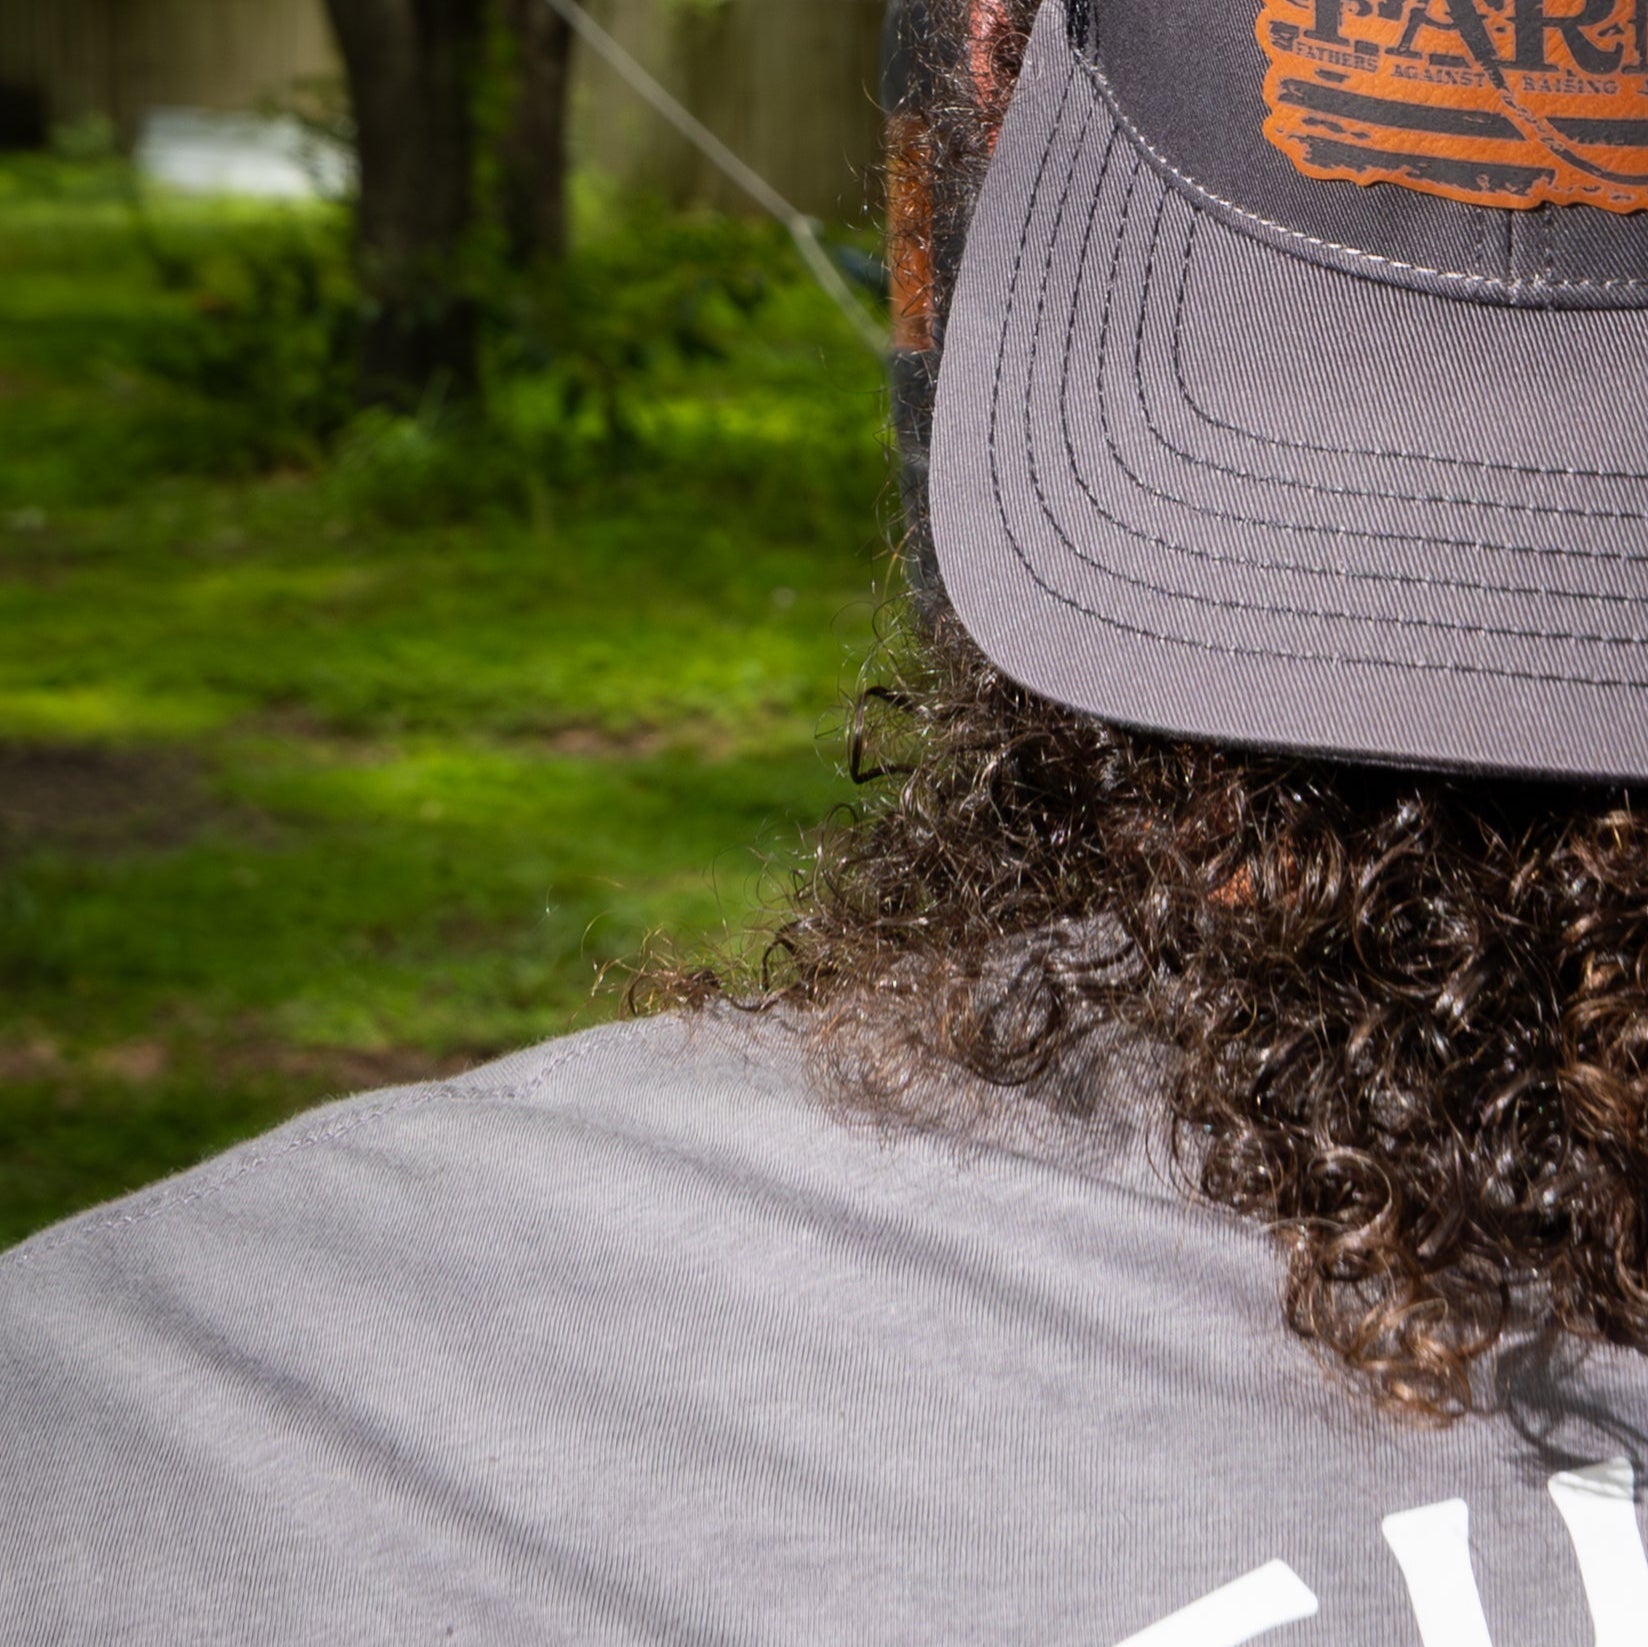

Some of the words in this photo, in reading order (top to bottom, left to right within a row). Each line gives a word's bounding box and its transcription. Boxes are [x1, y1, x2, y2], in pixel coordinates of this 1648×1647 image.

[1297, 44, 1379, 73] FATHERS
[1391, 61, 1486, 88] AGAINST
[1520, 74, 1619, 96] RAISING
